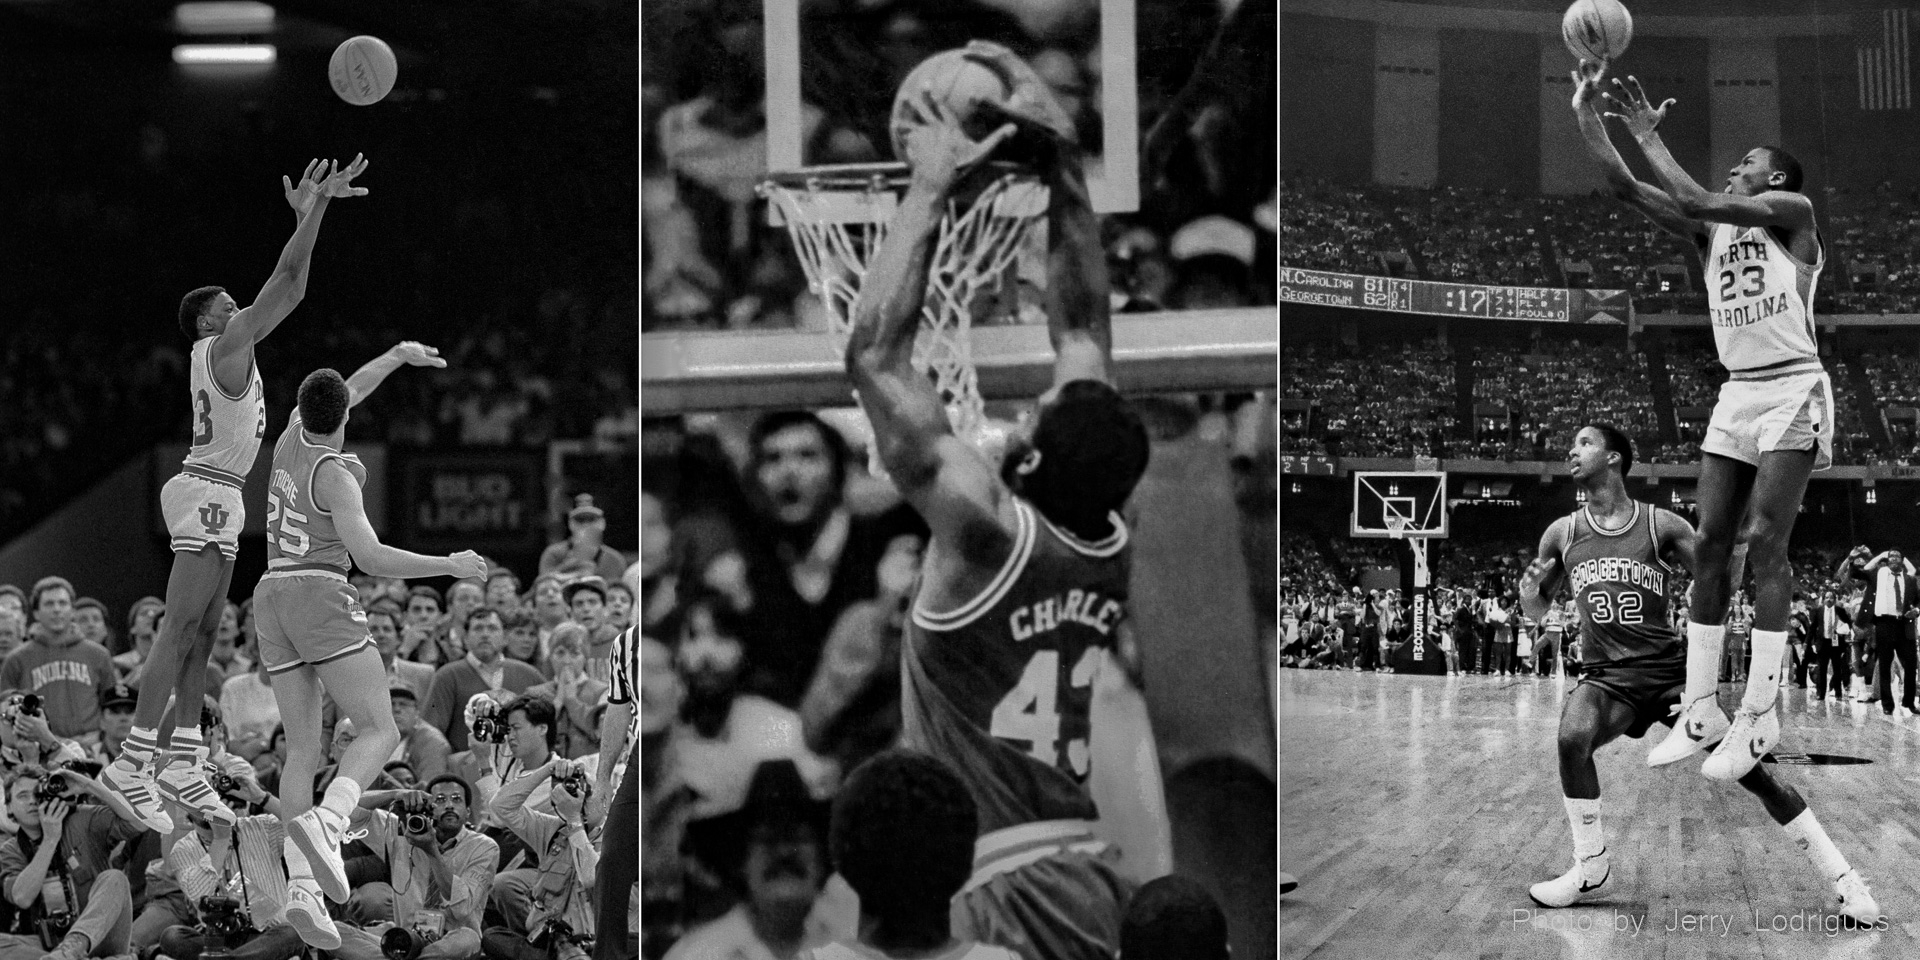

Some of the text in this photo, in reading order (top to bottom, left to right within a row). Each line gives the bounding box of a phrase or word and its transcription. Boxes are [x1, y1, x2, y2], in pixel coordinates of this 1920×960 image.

[1363, 292, 1387, 306] 62
[1364, 278, 1384, 293] 61
[1519, 288, 1562, 301] HALF 2
[1720, 265, 1765, 302] 23
[1284, 462, 1291, 473] 2
[267, 491, 311, 557] 25
[1588, 591, 1643, 624] 32
[1413, 594, 1424, 661] SUPERDOME
[32, 660, 92, 692] INDIANA
